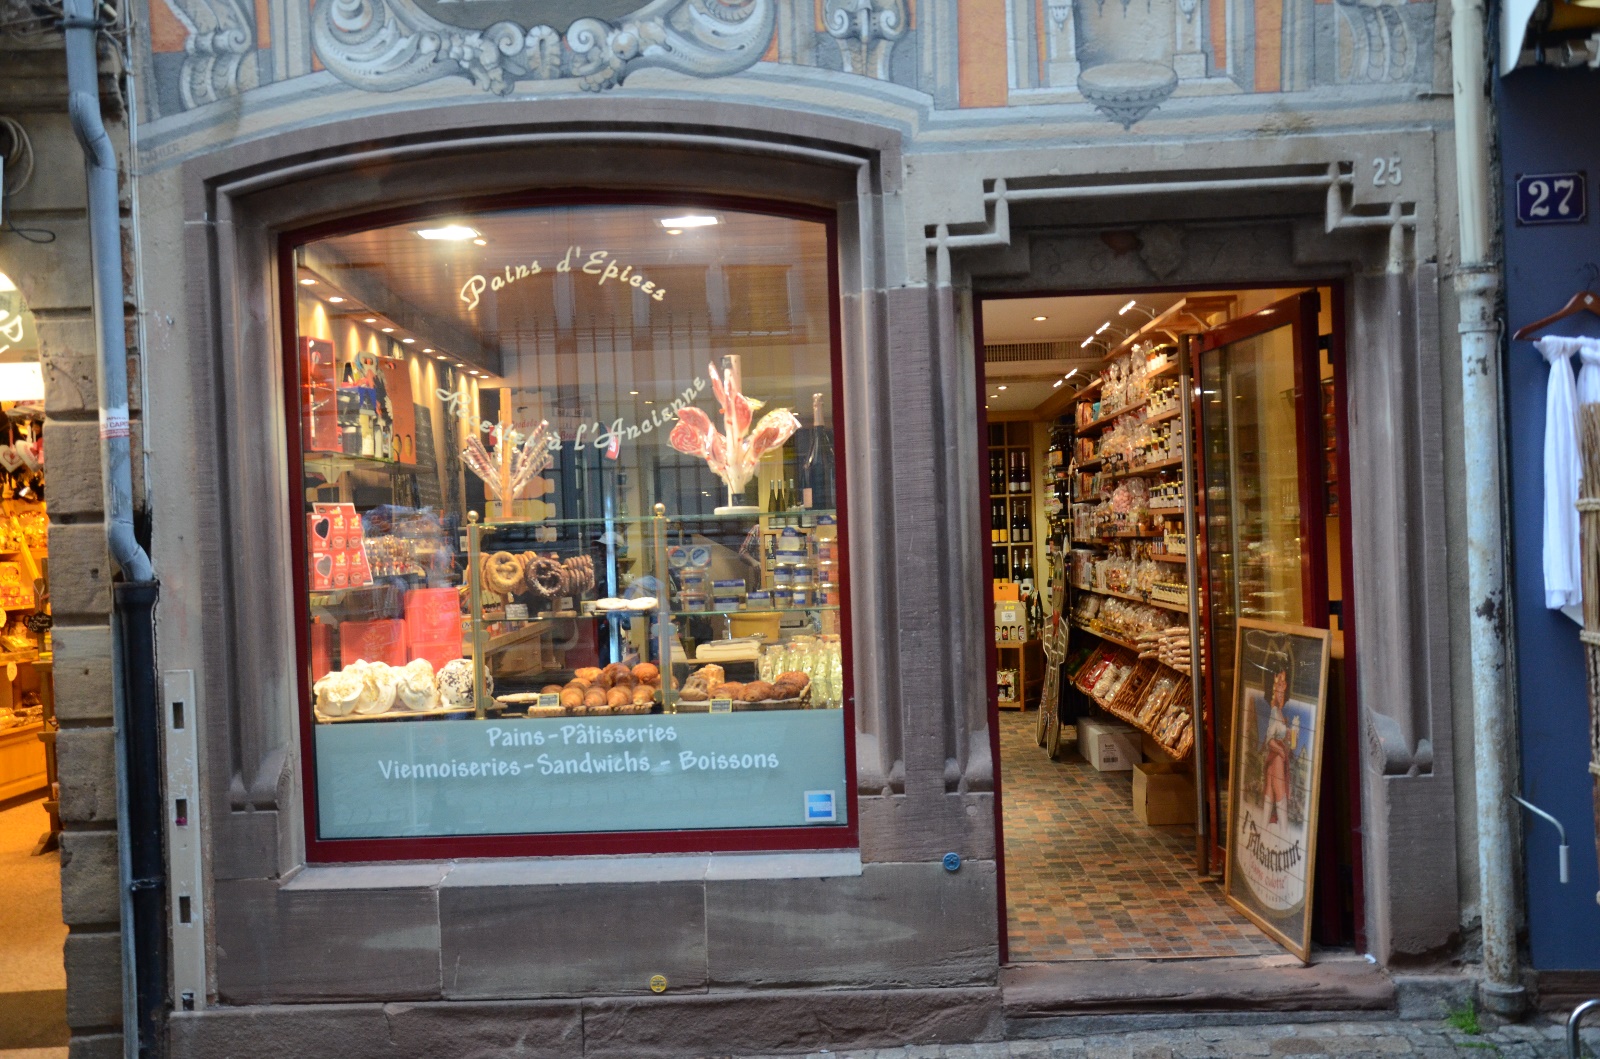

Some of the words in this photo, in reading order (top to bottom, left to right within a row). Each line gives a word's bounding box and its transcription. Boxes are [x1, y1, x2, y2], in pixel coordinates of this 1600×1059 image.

[1372, 157, 1402, 187] 25
[1527, 178, 1575, 218] 27
[460, 260, 542, 311] Pains
[556, 246, 667, 301] d'Epices
[548, 432, 563, 450] à
[574, 376, 706, 451] l'Ancienne
[679, 751, 780, 771] Boissons
